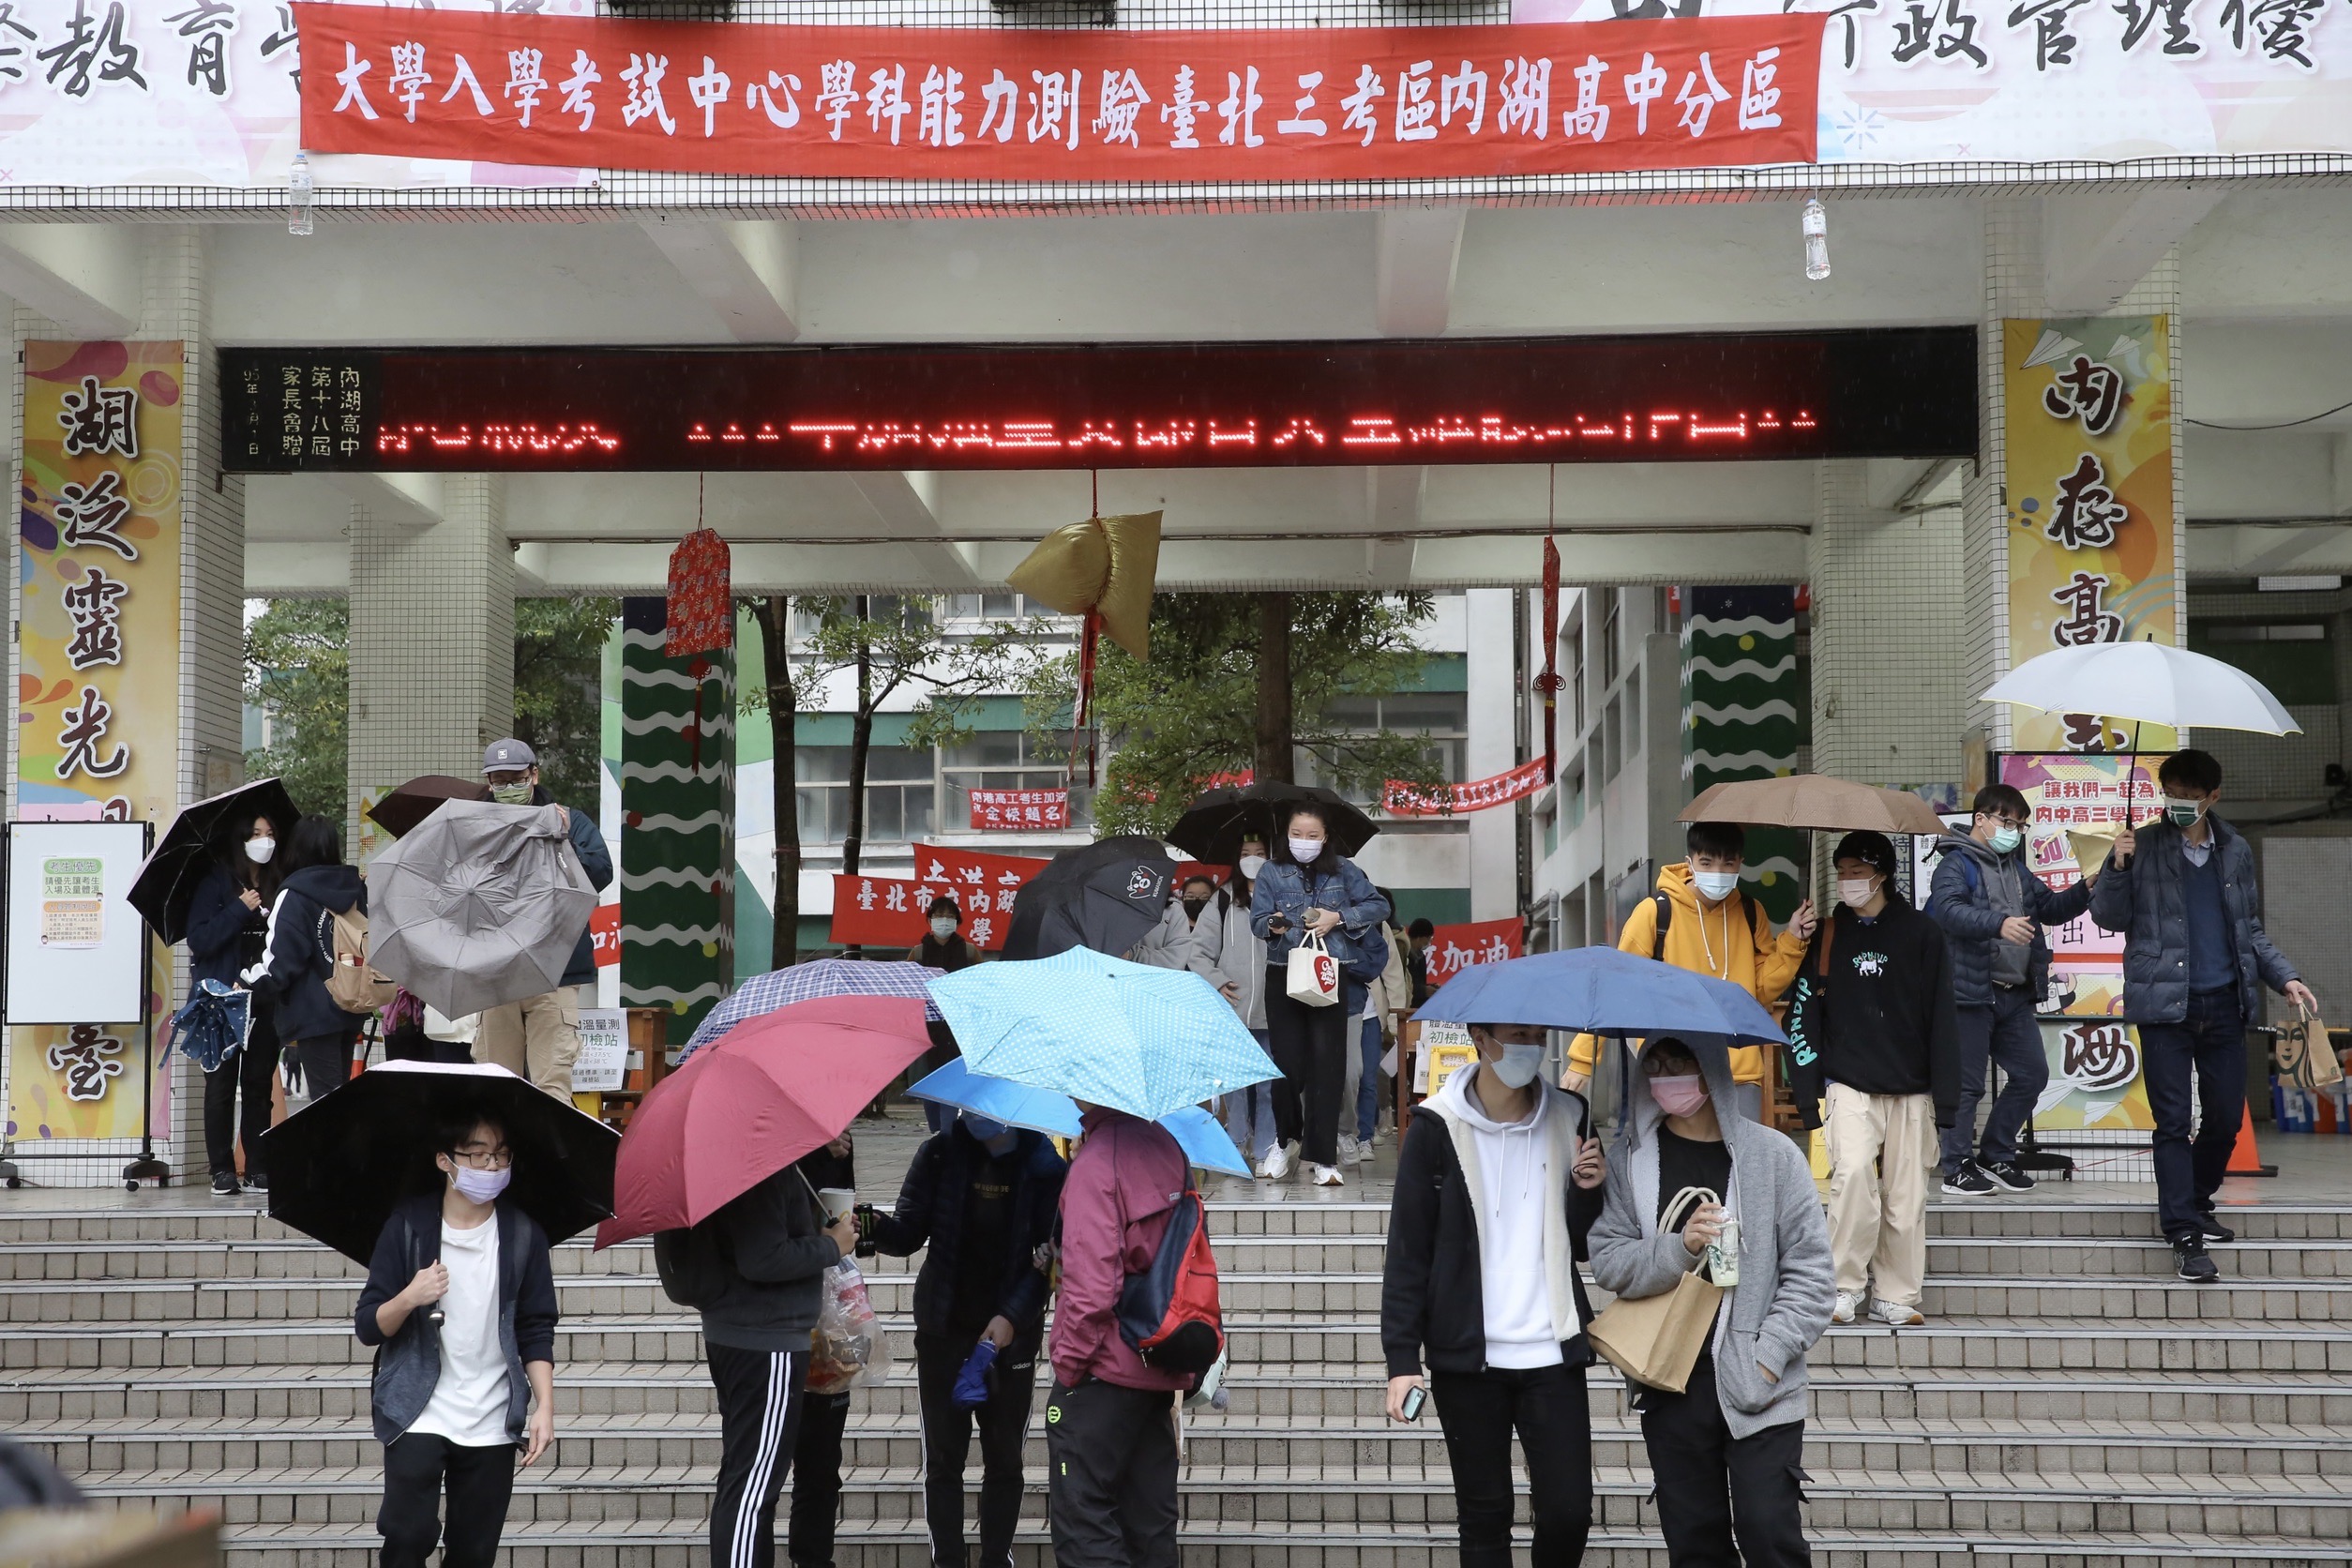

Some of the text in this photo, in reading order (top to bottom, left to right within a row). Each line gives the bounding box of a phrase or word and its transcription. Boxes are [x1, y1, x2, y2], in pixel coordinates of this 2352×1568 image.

[282, 366, 304, 456] 家長會贈
[310, 366, 332, 457] 第十八屆
[339, 367, 361, 458] 內湖高中
[2043, 780, 2156, 799] 讓我們一起為
[50, 861, 97, 873] 考生優先
[969, 917, 993, 947] 學
[1429, 1031, 1474, 1047] 初檢站
[1790, 977, 1818, 1067] RIPNDIP
